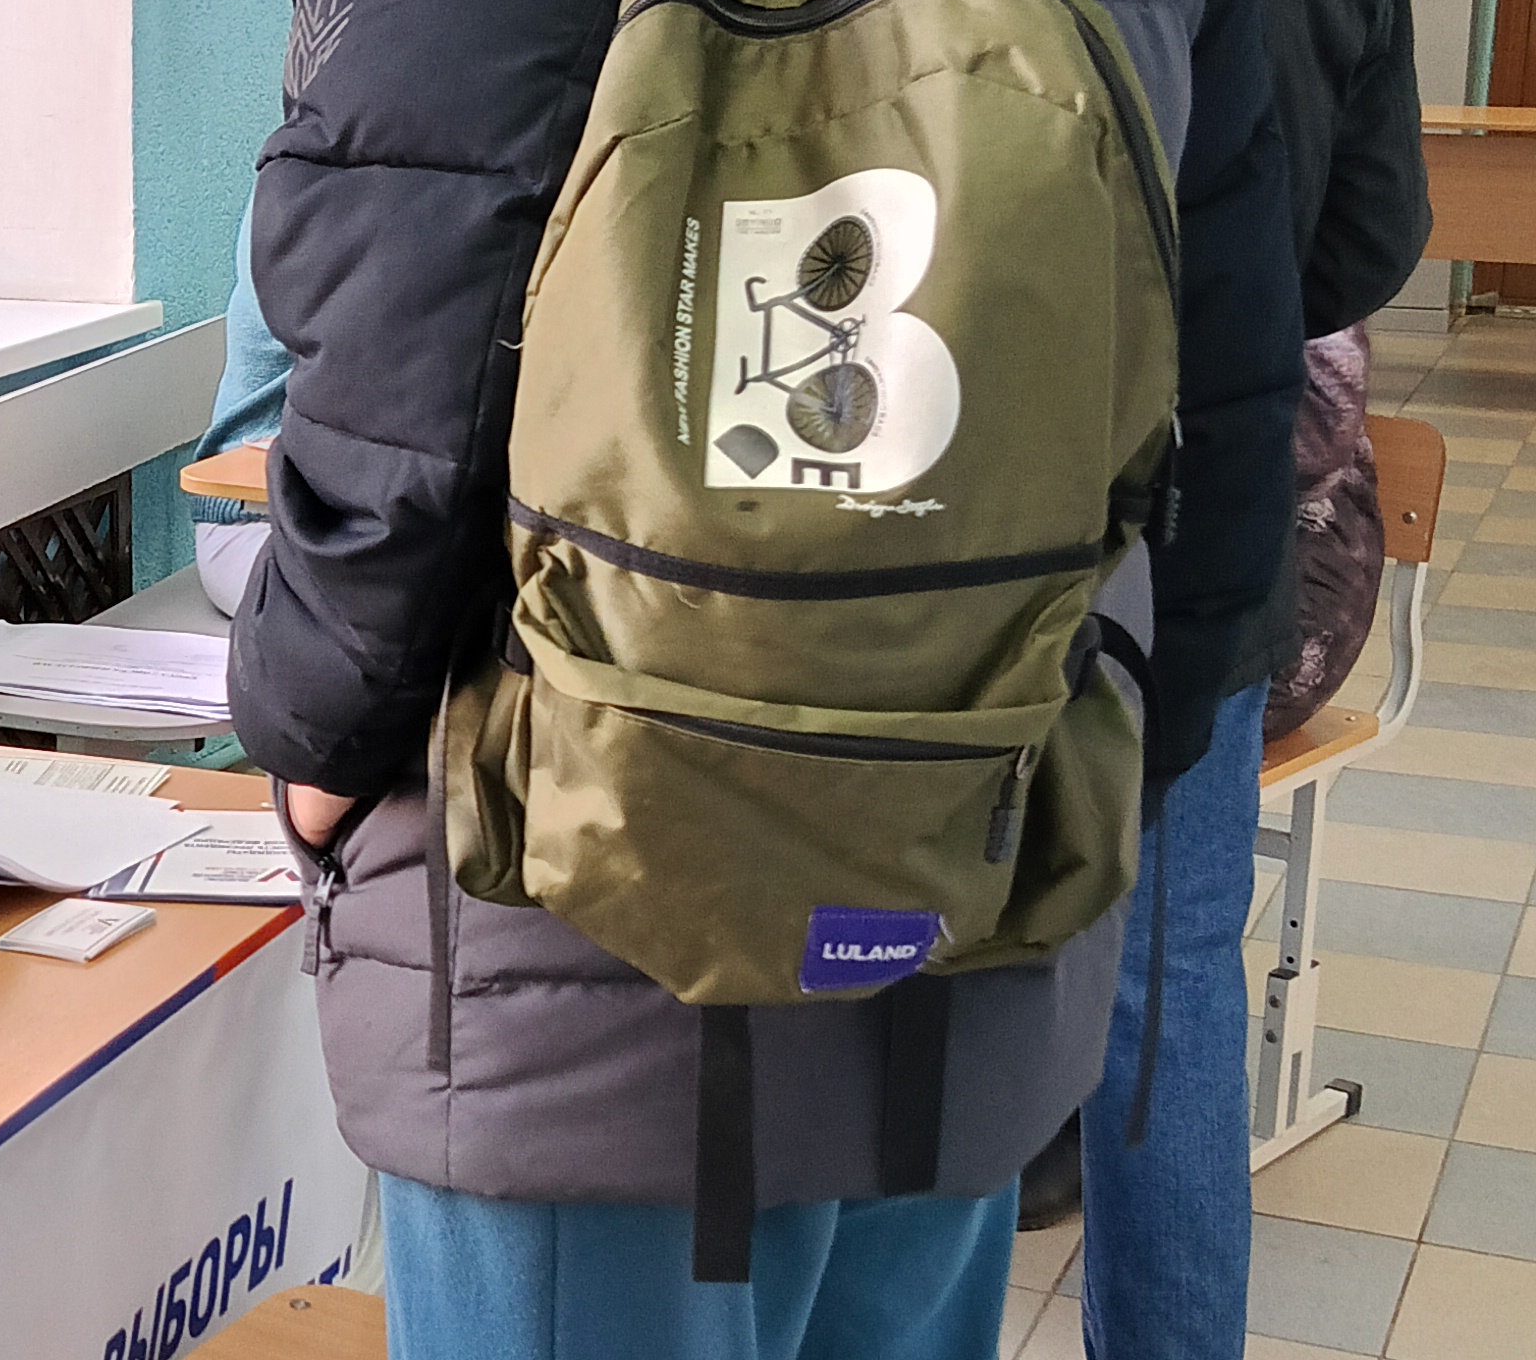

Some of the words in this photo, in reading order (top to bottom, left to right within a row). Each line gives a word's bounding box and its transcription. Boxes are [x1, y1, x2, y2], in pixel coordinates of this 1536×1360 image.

[680, 217, 701, 279] MAKES
[676, 279, 695, 325] STAR
[672, 325, 692, 403] FASHION
[822, 942, 917, 961] LULAND
